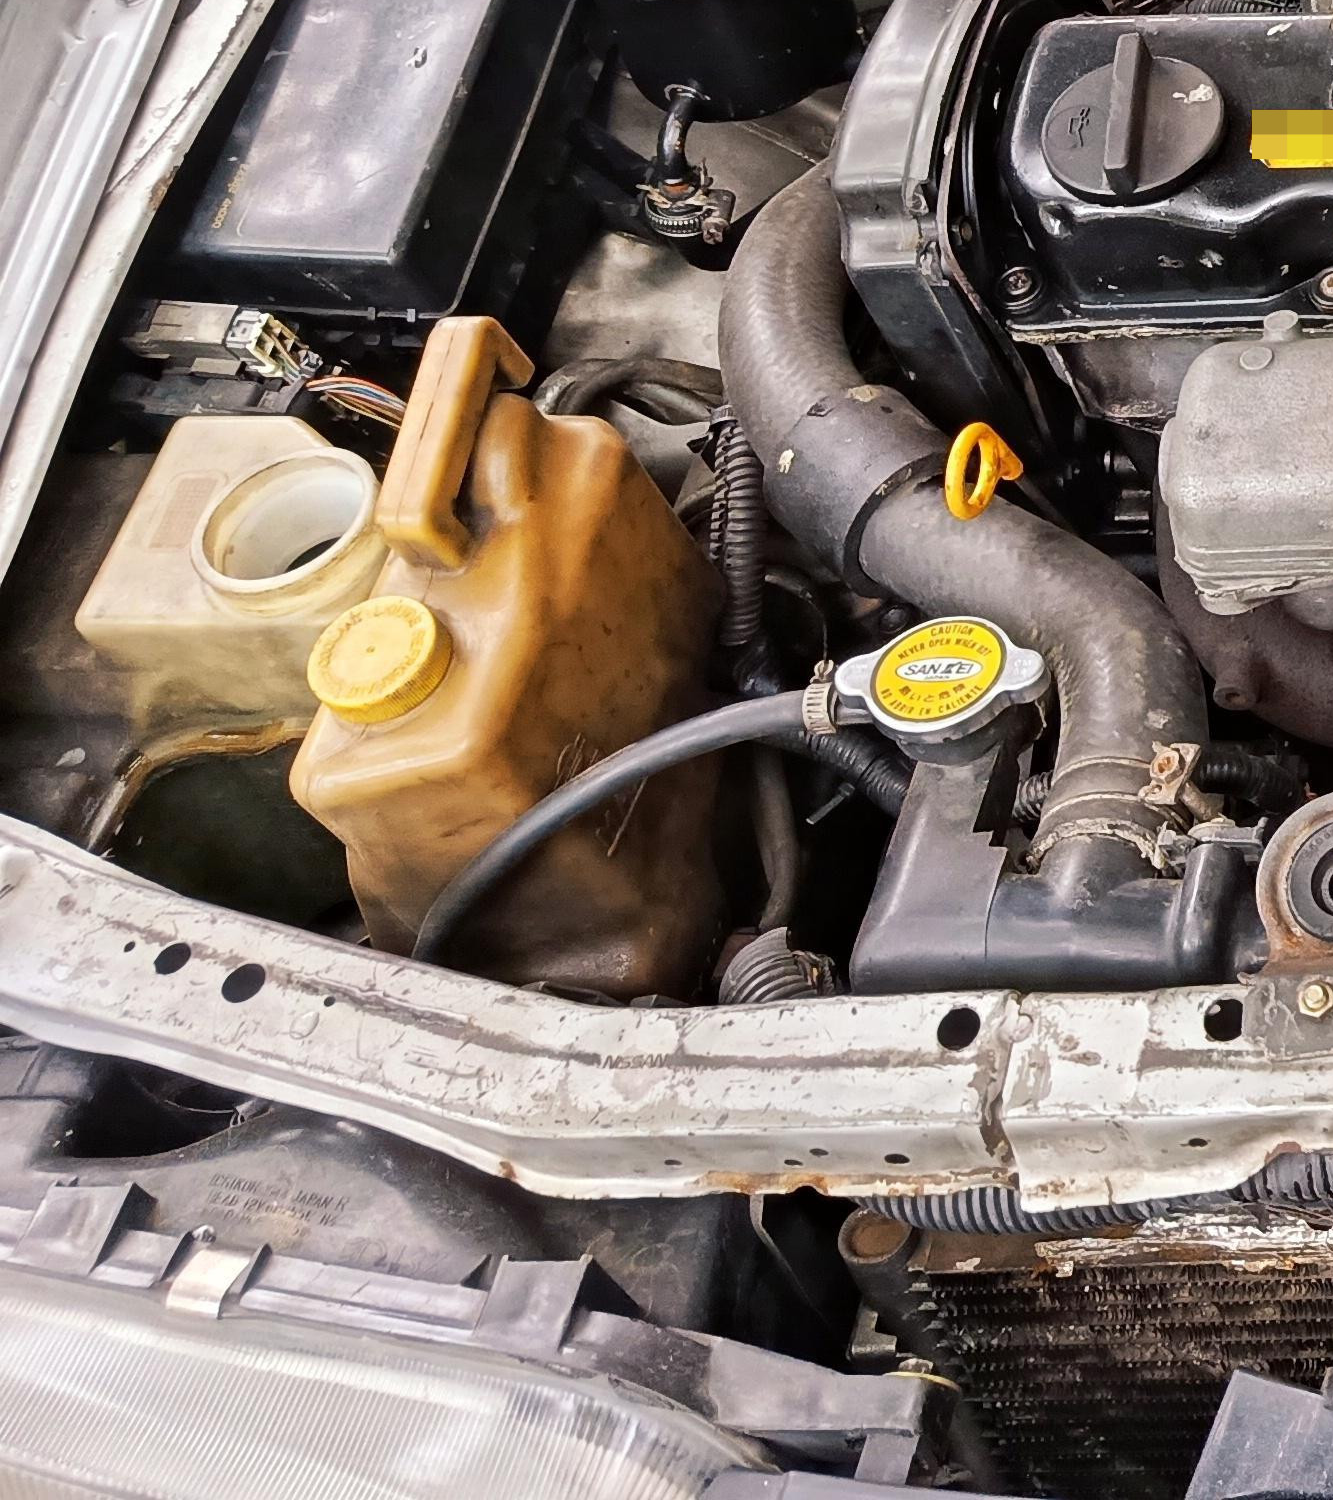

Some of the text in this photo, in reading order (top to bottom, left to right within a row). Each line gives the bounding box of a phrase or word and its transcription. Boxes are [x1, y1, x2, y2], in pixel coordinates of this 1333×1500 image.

[931, 625, 975, 637] CAUTION
[898, 642, 925, 660] NEVER
[929, 638, 950, 647] OPEN
[955, 638, 977, 649] WHEN
[905, 661, 973, 676] SANKEI
[602, 1053, 668, 1070] NISSAN
